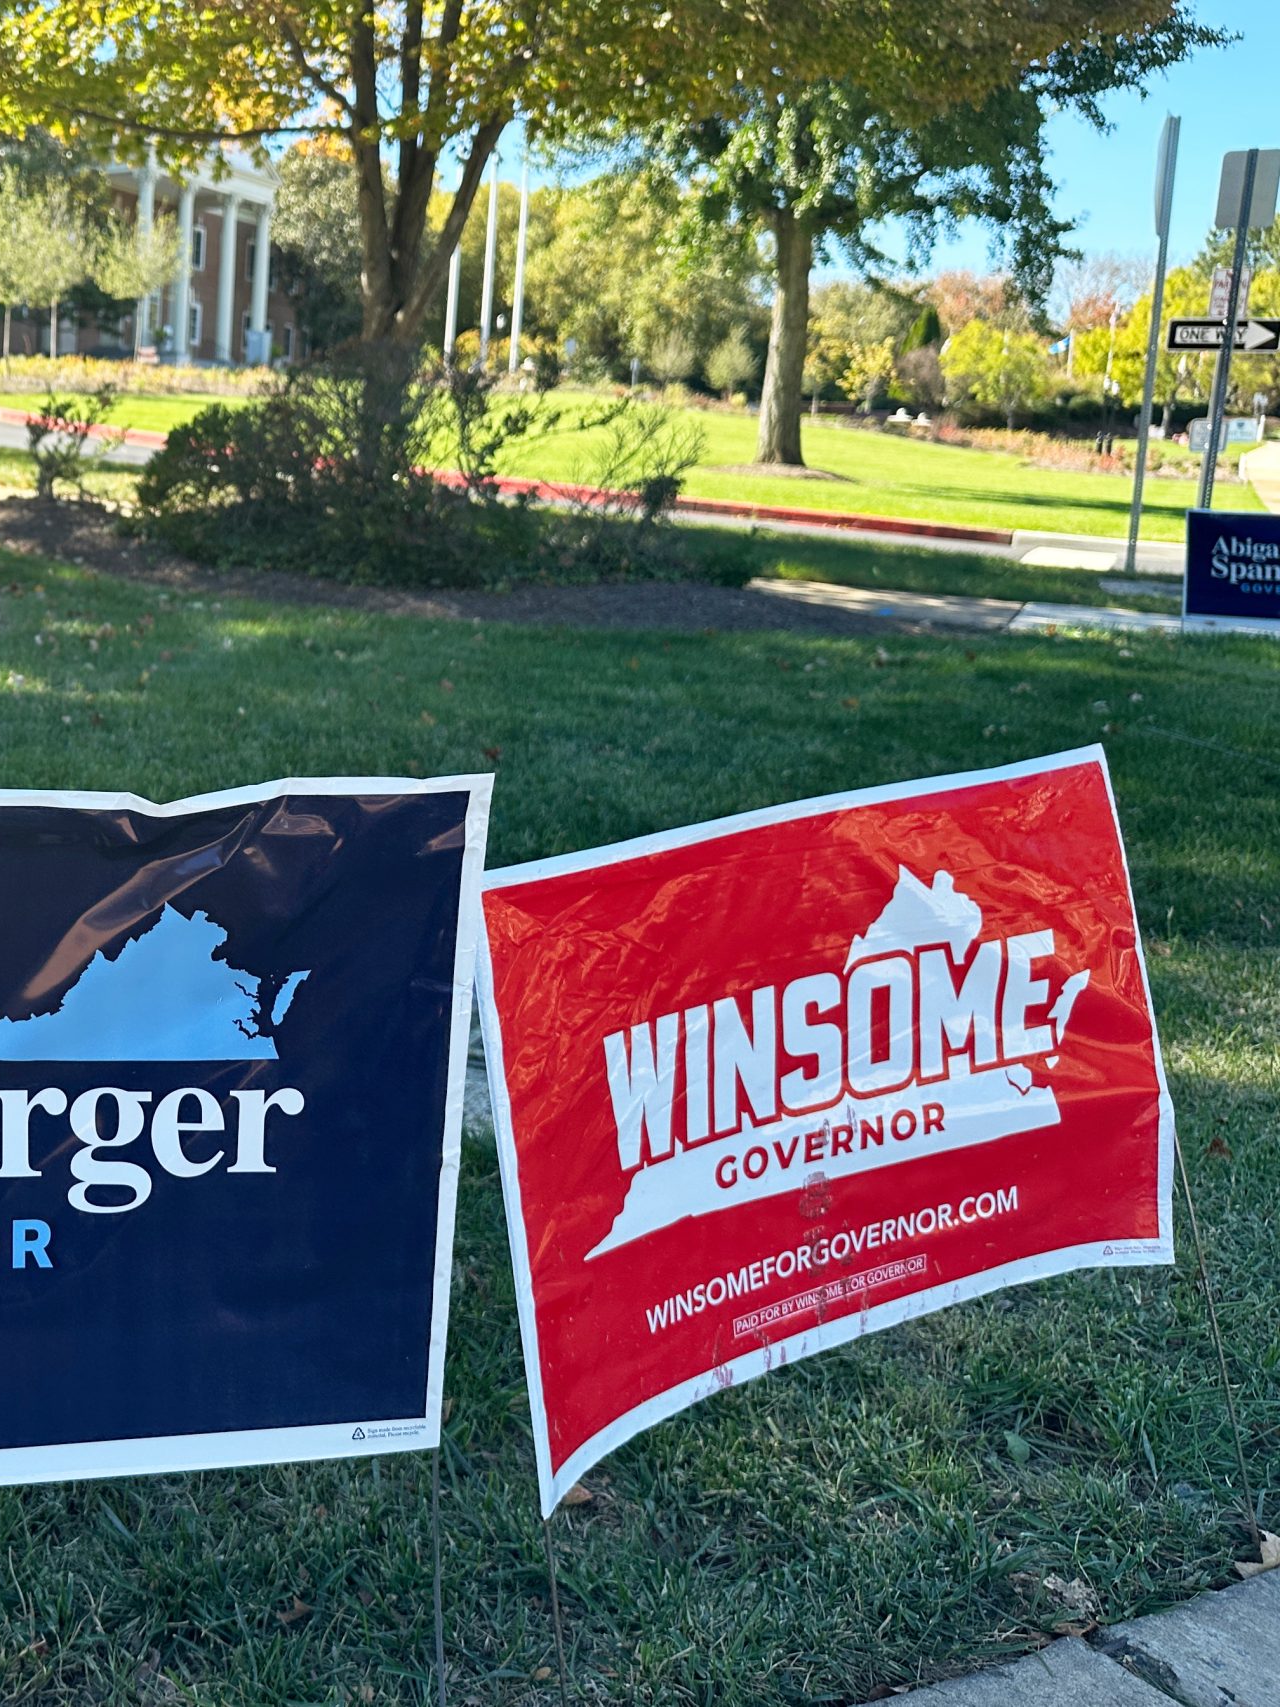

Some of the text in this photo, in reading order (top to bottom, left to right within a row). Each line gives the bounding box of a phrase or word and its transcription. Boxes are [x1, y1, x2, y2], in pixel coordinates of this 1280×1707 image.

[1180, 327, 1247, 341] ONE WY
[603, 929, 1055, 1172] WINSOME
[715, 1101, 946, 1190] GOVERNOR
[645, 1185, 1019, 1335] WINSOMEFORGOVERNOR.COM
[736, 1315, 758, 1333] PAID
[760, 1308, 780, 1324] FOR
[782, 1301, 794, 1315] BY
[867, 1258, 923, 1284] GOVERNOR
